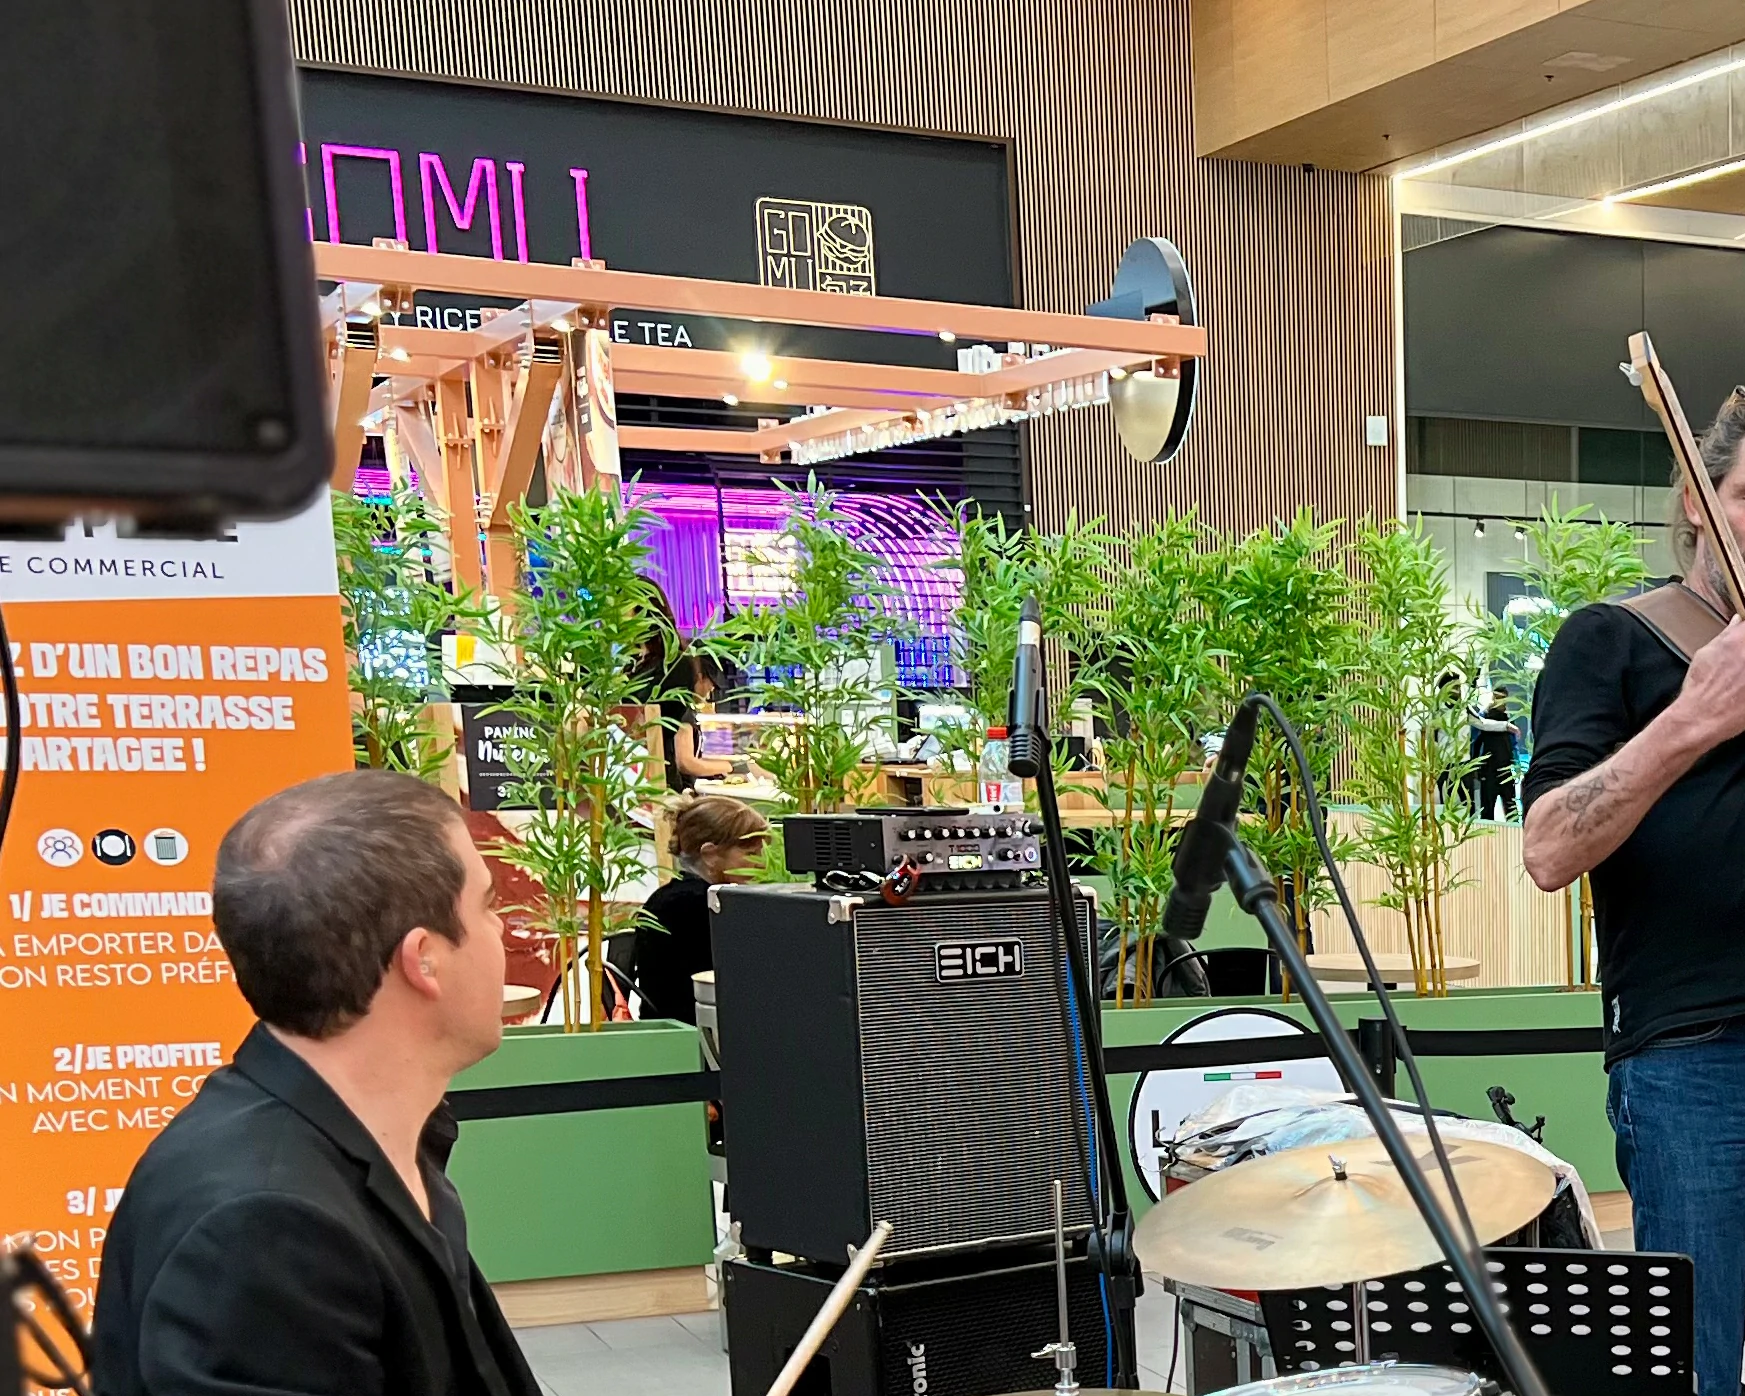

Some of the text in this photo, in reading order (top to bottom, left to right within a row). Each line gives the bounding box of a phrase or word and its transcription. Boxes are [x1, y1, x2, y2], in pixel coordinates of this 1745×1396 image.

[318, 143, 590, 264] OMU
[764, 209, 811, 256] GO
[415, 305, 482, 332] RICE
[637, 321, 693, 348] TEA
[26, 556, 225, 579] COMMERCIAL
[29, 642, 122, 679] D'UN
[127, 644, 204, 681] BON
[209, 645, 329, 683] REPAS
[0, 692, 296, 731] TRE TERRASSE
[0, 735, 187, 772] ARTAGEE
[9, 890, 214, 922] 1/ JE COMMAND
[13, 932, 176, 958] EMPORTER
[184, 930, 224, 954] DA
[56, 962, 152, 987] RESTO
[161, 956, 237, 985] PRÉF
[939, 942, 1022, 978] EICH
[116, 1041, 223, 1070] PROFITE
[27, 1075, 163, 1104] MOMENT
[32, 1105, 176, 1134] AVEC MES
